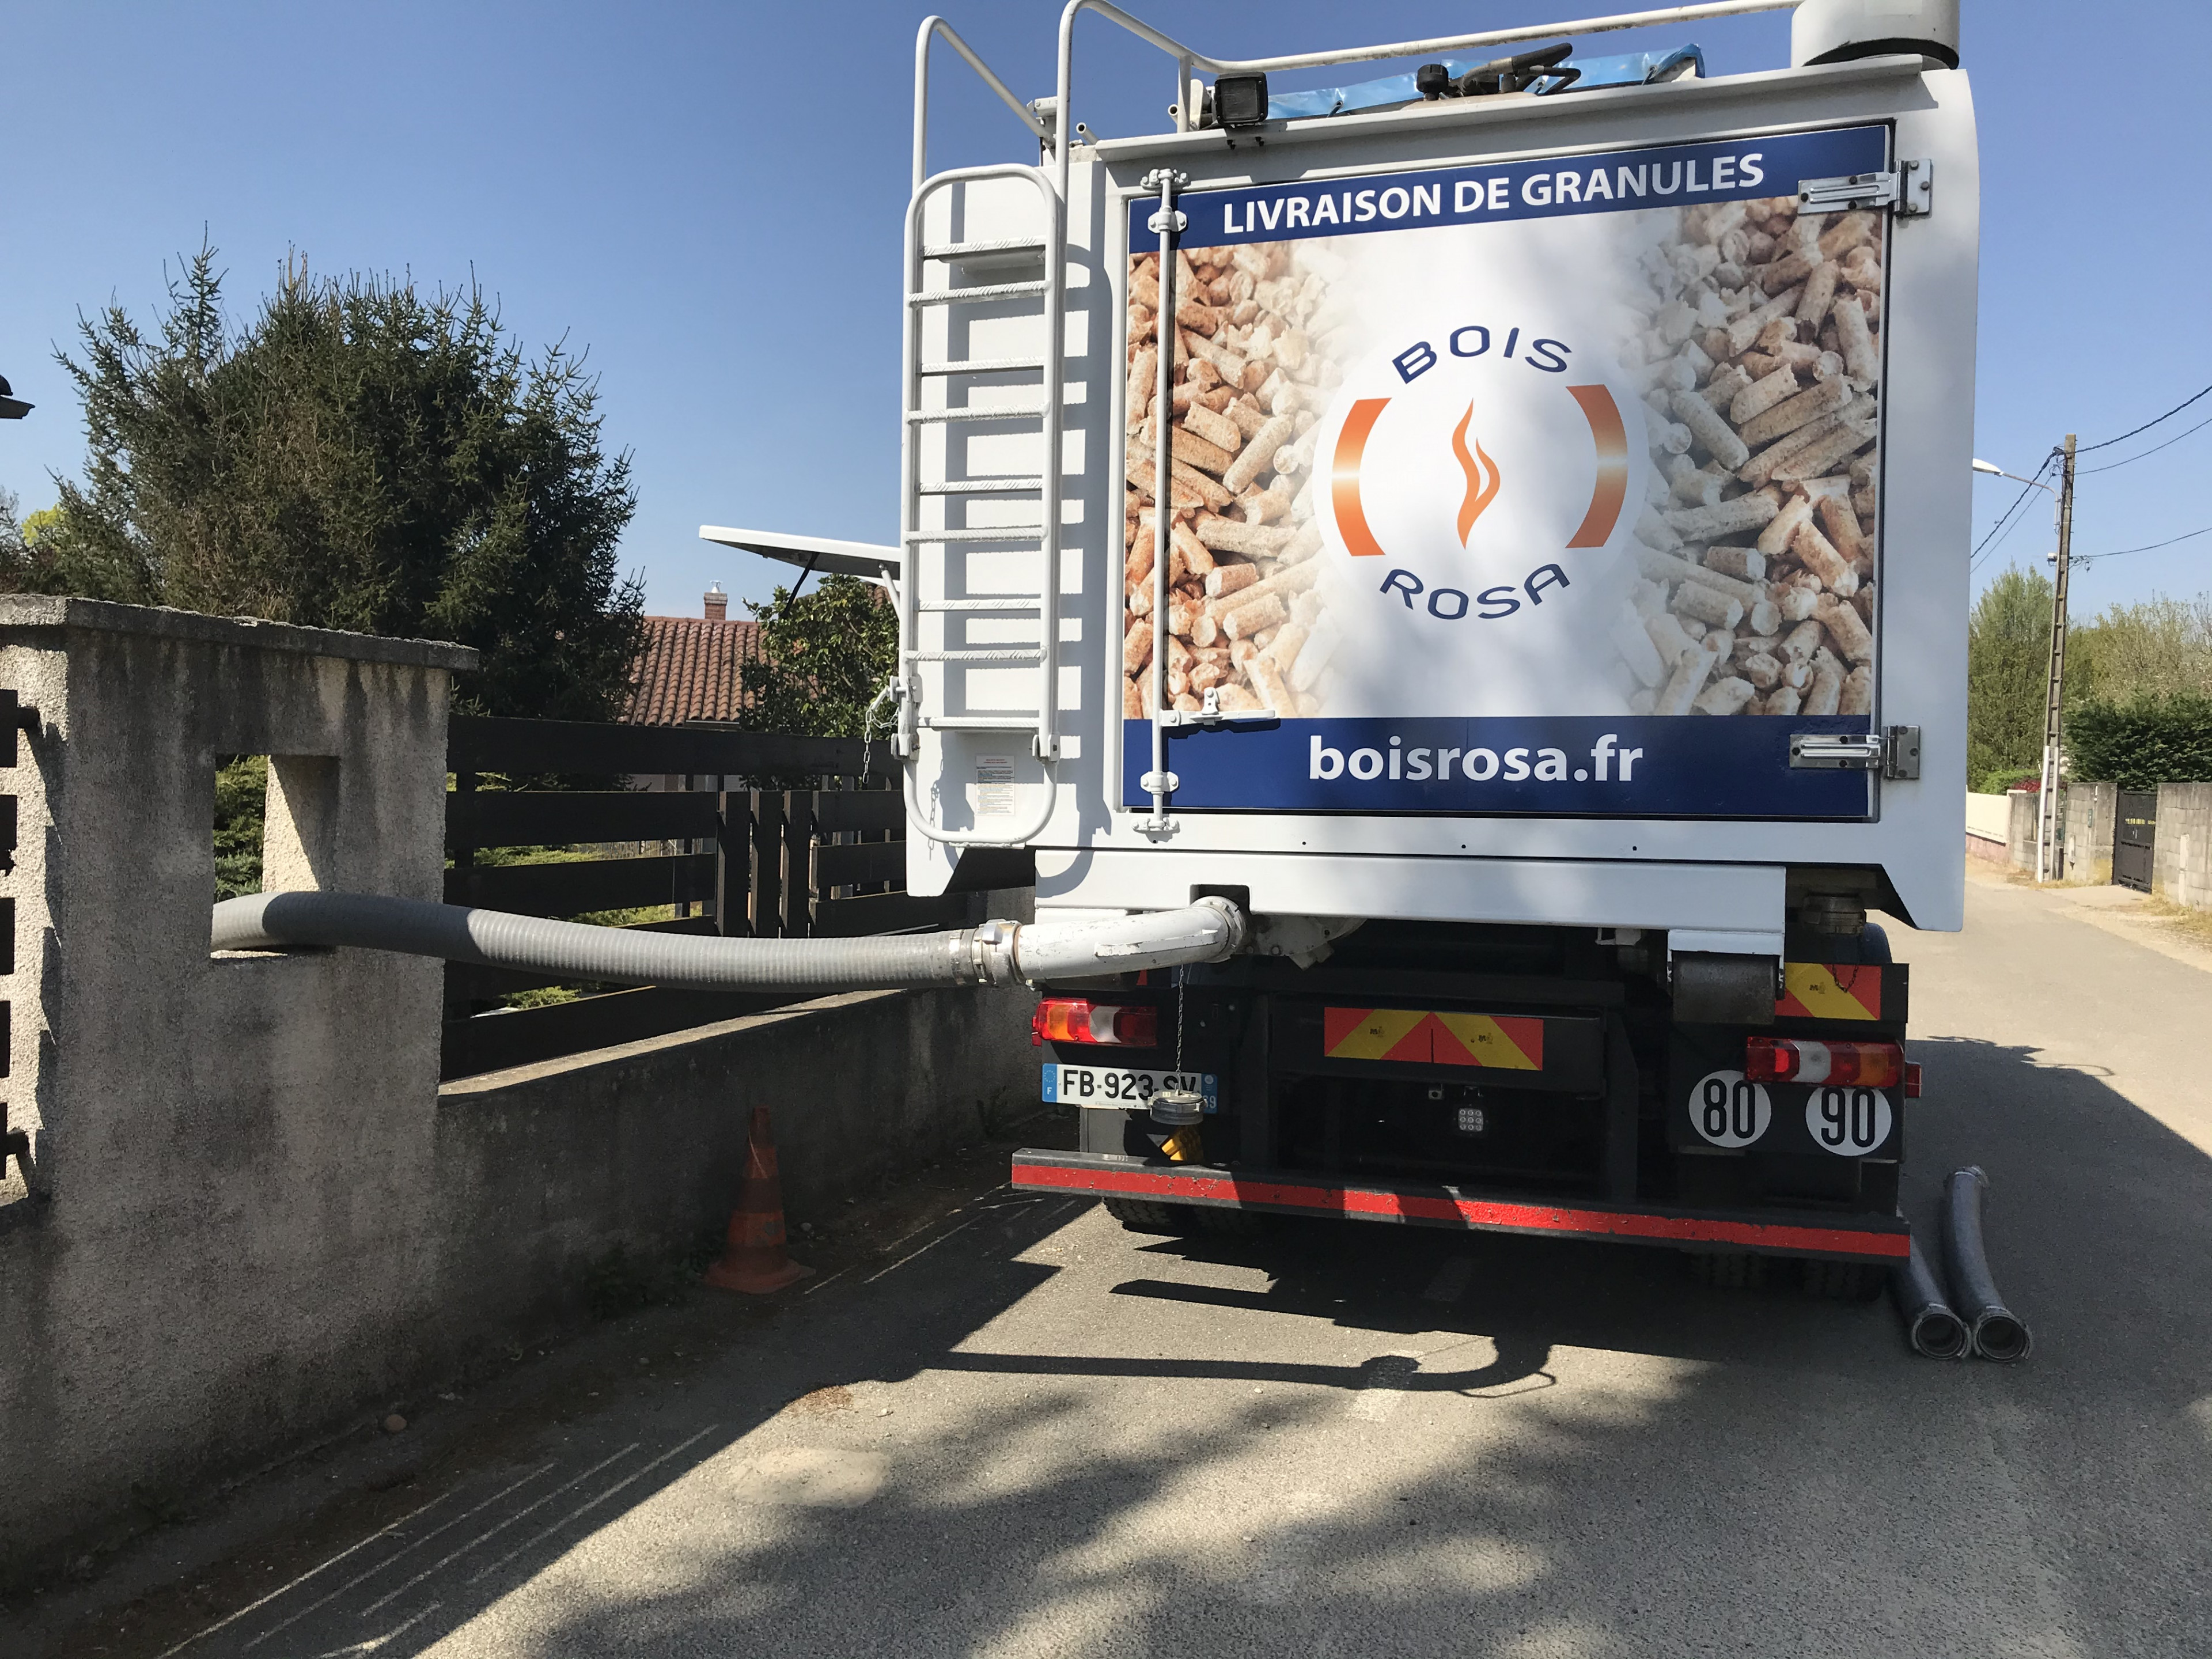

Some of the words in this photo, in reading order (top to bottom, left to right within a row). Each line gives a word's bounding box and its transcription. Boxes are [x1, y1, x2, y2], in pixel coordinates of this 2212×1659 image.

[1223, 183, 1441, 234] LIVRAISON
[1453, 176, 1510, 213] DE
[1521, 152, 1764, 206] GRANULES
[1392, 325, 1572, 384] BOIS
[1380, 563, 1571, 620] ROSA
[1309, 733, 1643, 782] boisrosa.fr
[1047, 1086, 1052, 1095] F
[1703, 1078, 1756, 1139] 80
[1820, 1087, 1876, 1147] 90
